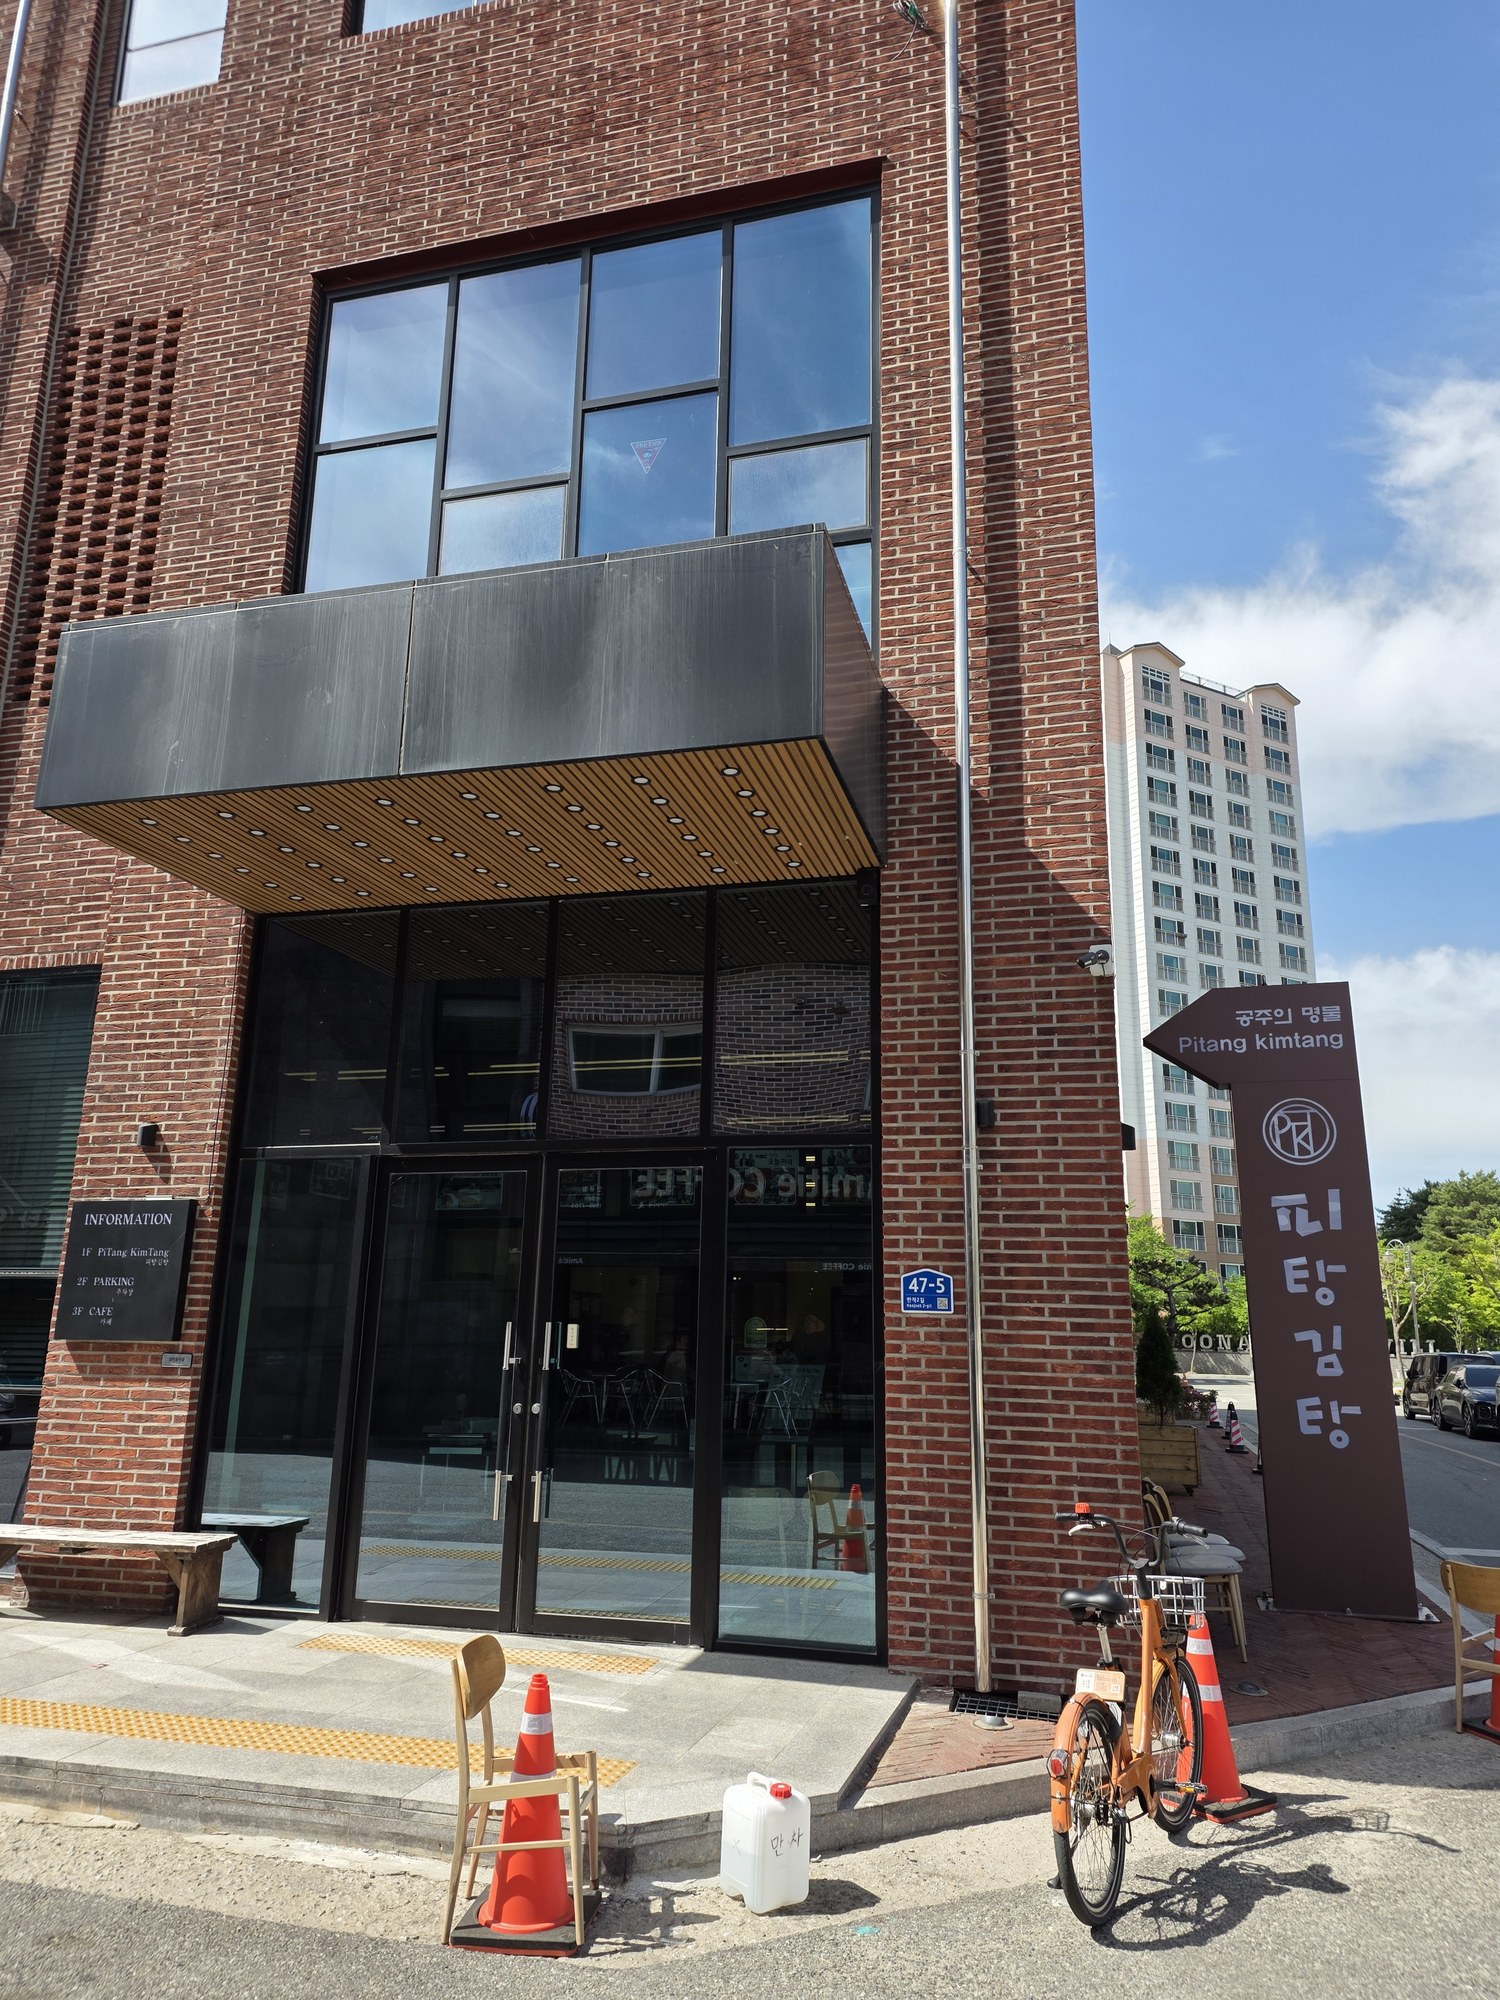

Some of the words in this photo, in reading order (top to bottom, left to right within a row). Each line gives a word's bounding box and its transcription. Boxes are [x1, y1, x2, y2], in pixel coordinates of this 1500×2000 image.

[1235, 1008, 1293, 1027] 공주의
[1301, 1005, 1342, 1024] 명물
[1179, 1036, 1247, 1053] Pitang
[1255, 1031, 1344, 1050] kimtang
[84, 1213, 173, 1226] INFORMATION
[82, 1248, 93, 1257] 1F
[97, 1247, 128, 1258] PiTang
[130, 1247, 170, 1258] KimTang
[77, 1277, 89, 1286] 2F
[93, 1276, 135, 1286] PARKING
[908, 1277, 946, 1293] 47-5
[72, 1306, 84, 1316] 3F
[89, 1306, 114, 1316] CAFE
[1271, 1188, 1362, 1450] 피탕김탕
